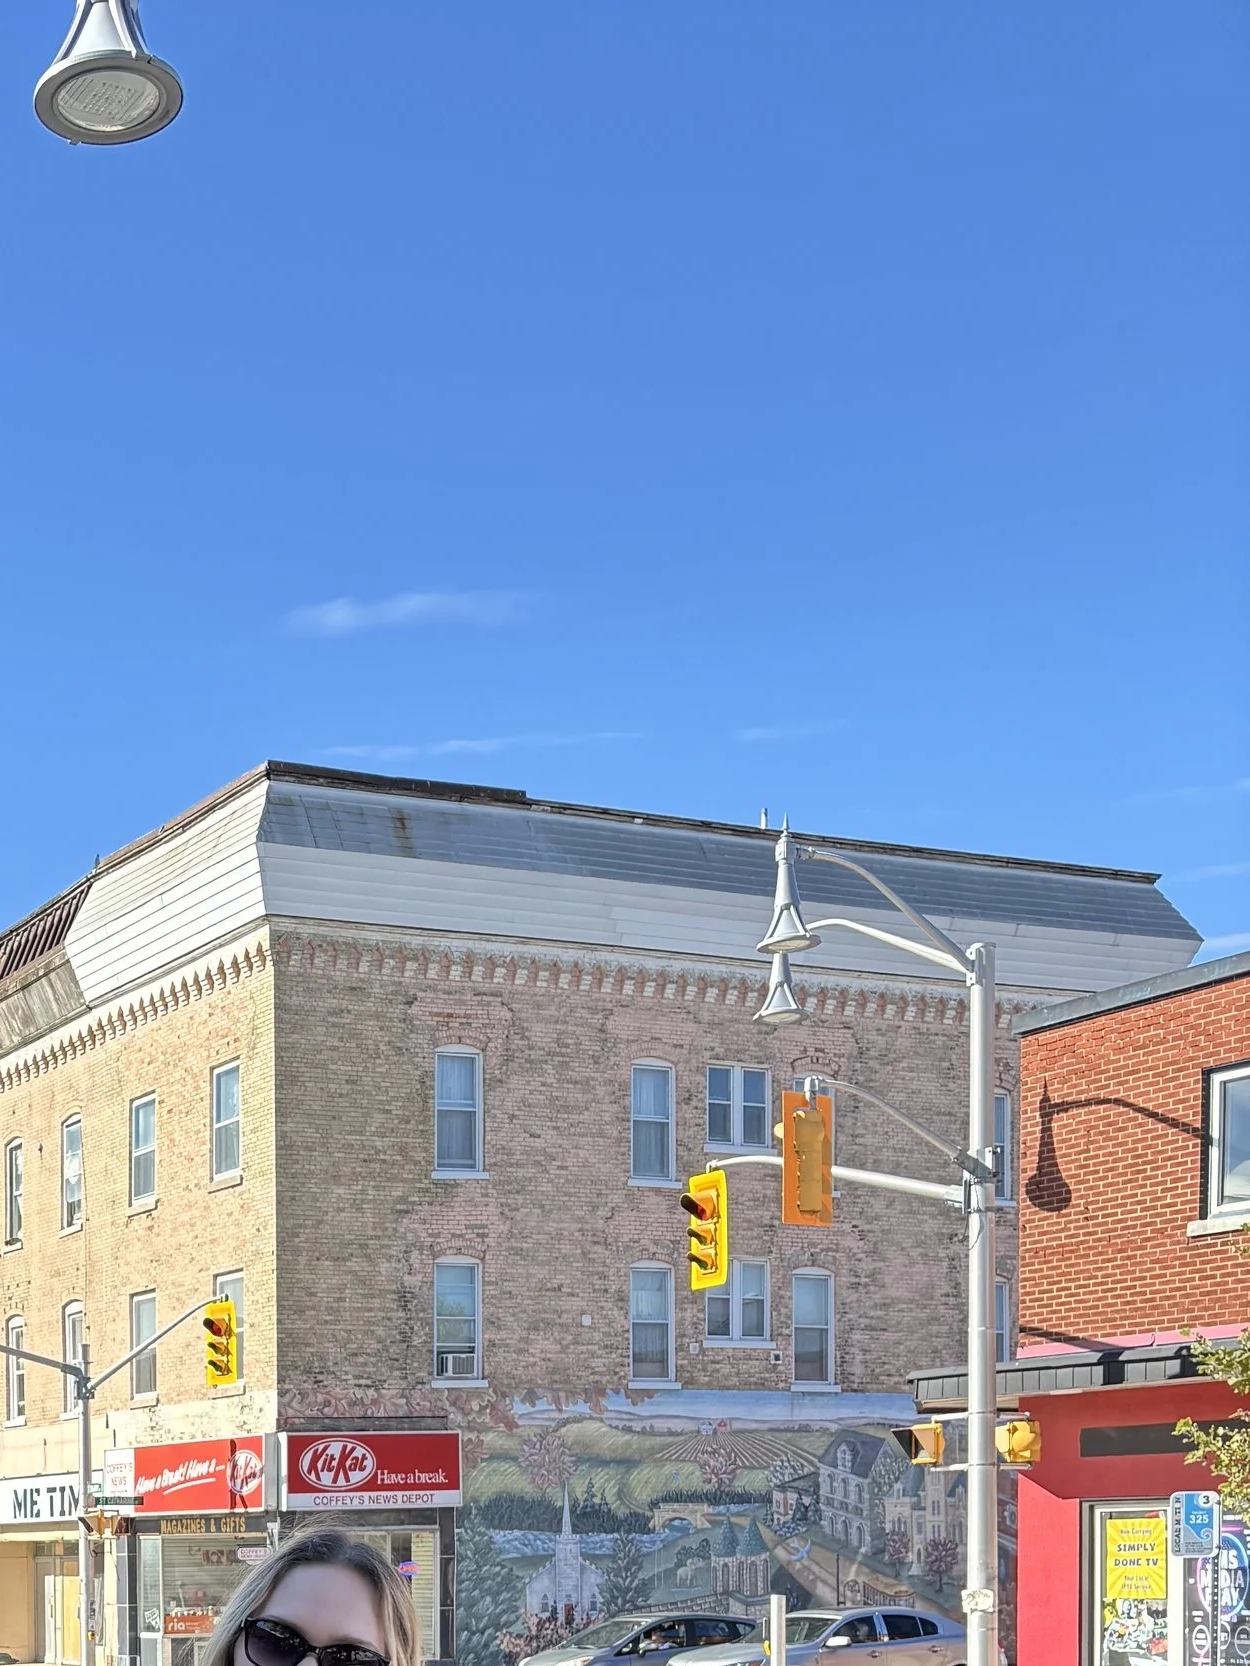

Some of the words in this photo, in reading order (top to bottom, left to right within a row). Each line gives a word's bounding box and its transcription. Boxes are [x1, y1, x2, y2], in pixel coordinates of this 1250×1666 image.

[377, 1469, 406, 1485] Have
[407, 1473, 414, 1484] a
[415, 1468, 449, 1484] break.
[13, 1488, 40, 1519] ME
[46, 1484, 80, 1518] TIM
[313, 1494, 365, 1506] COFFEY'S
[368, 1494, 398, 1505] NEWS
[401, 1493, 435, 1504] DEPOT
[1202, 1495, 1210, 1505] 3
[160, 1518, 206, 1534] MAGAZINES
[210, 1518, 216, 1532] &
[220, 1516, 246, 1532] GIFTS
[1189, 1514, 1209, 1524] 325
[1117, 1543, 1155, 1552] SIMPLY
[1114, 1558, 1142, 1567] DONE
[1145, 1558, 1159, 1567] TV
[1200, 1569, 1244, 1588] MDIA
[168, 1618, 186, 1631] ria
